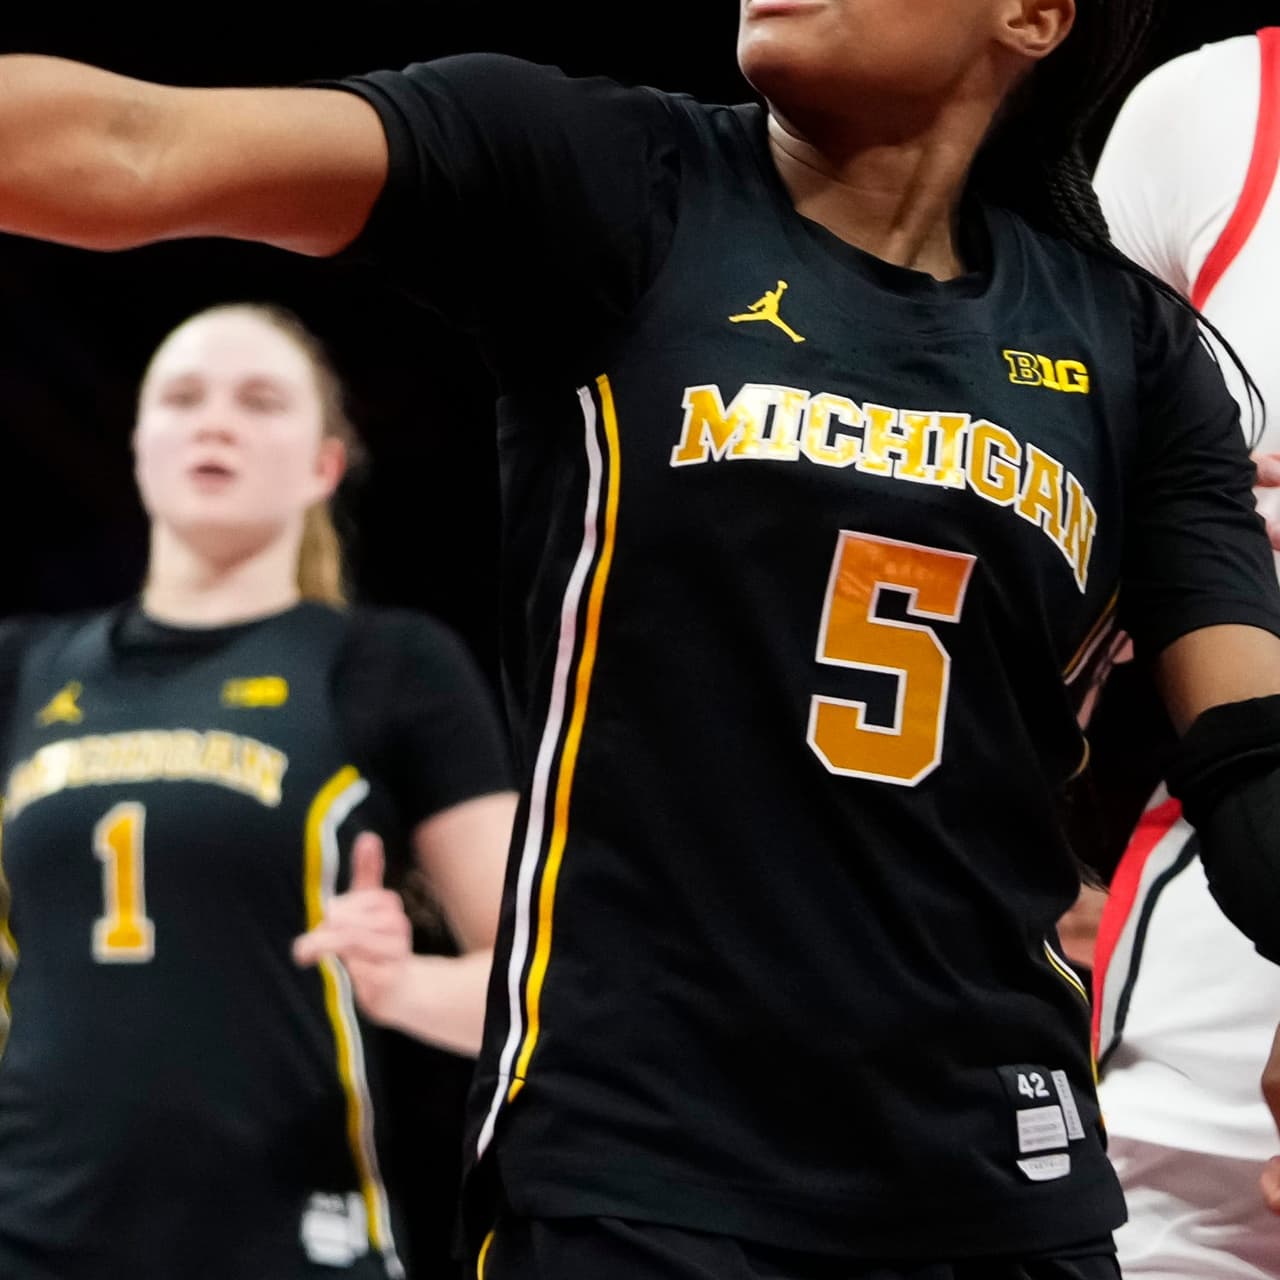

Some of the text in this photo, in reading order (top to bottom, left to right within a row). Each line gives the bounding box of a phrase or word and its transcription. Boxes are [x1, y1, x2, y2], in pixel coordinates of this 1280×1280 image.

[669, 382, 1098, 595] MICHIGAN
[806, 529, 978, 788] 5
[93, 801, 155, 963] 1
[1017, 1072, 1050, 1099] 42
